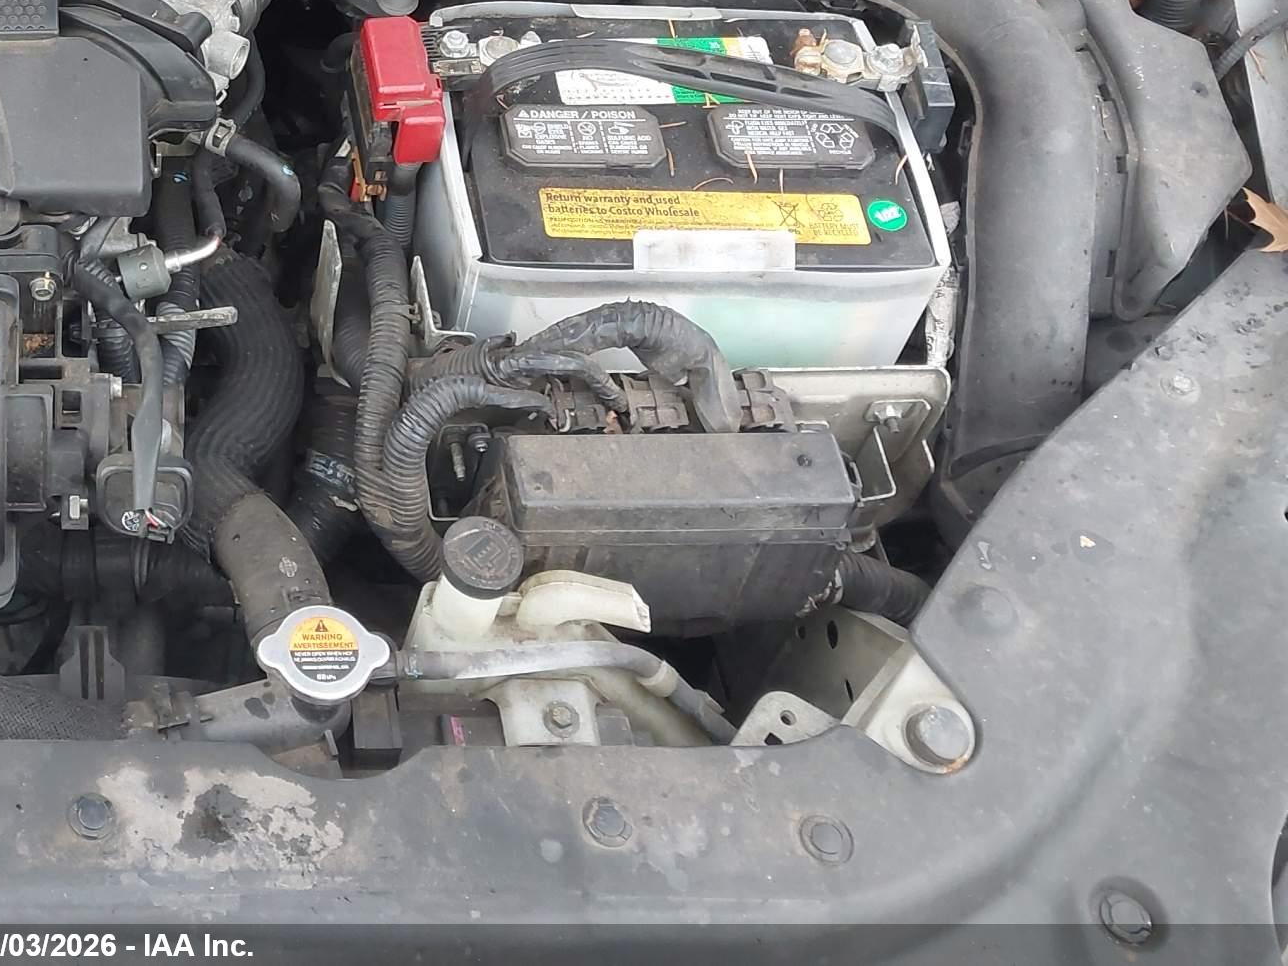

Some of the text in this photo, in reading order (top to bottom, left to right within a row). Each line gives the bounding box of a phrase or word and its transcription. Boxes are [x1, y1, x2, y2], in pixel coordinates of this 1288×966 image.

[530, 110, 636, 119] DANGER / POISON
[546, 193, 680, 206] Return warranty and used
[548, 204, 700, 217] batteries to Costco Wholesale
